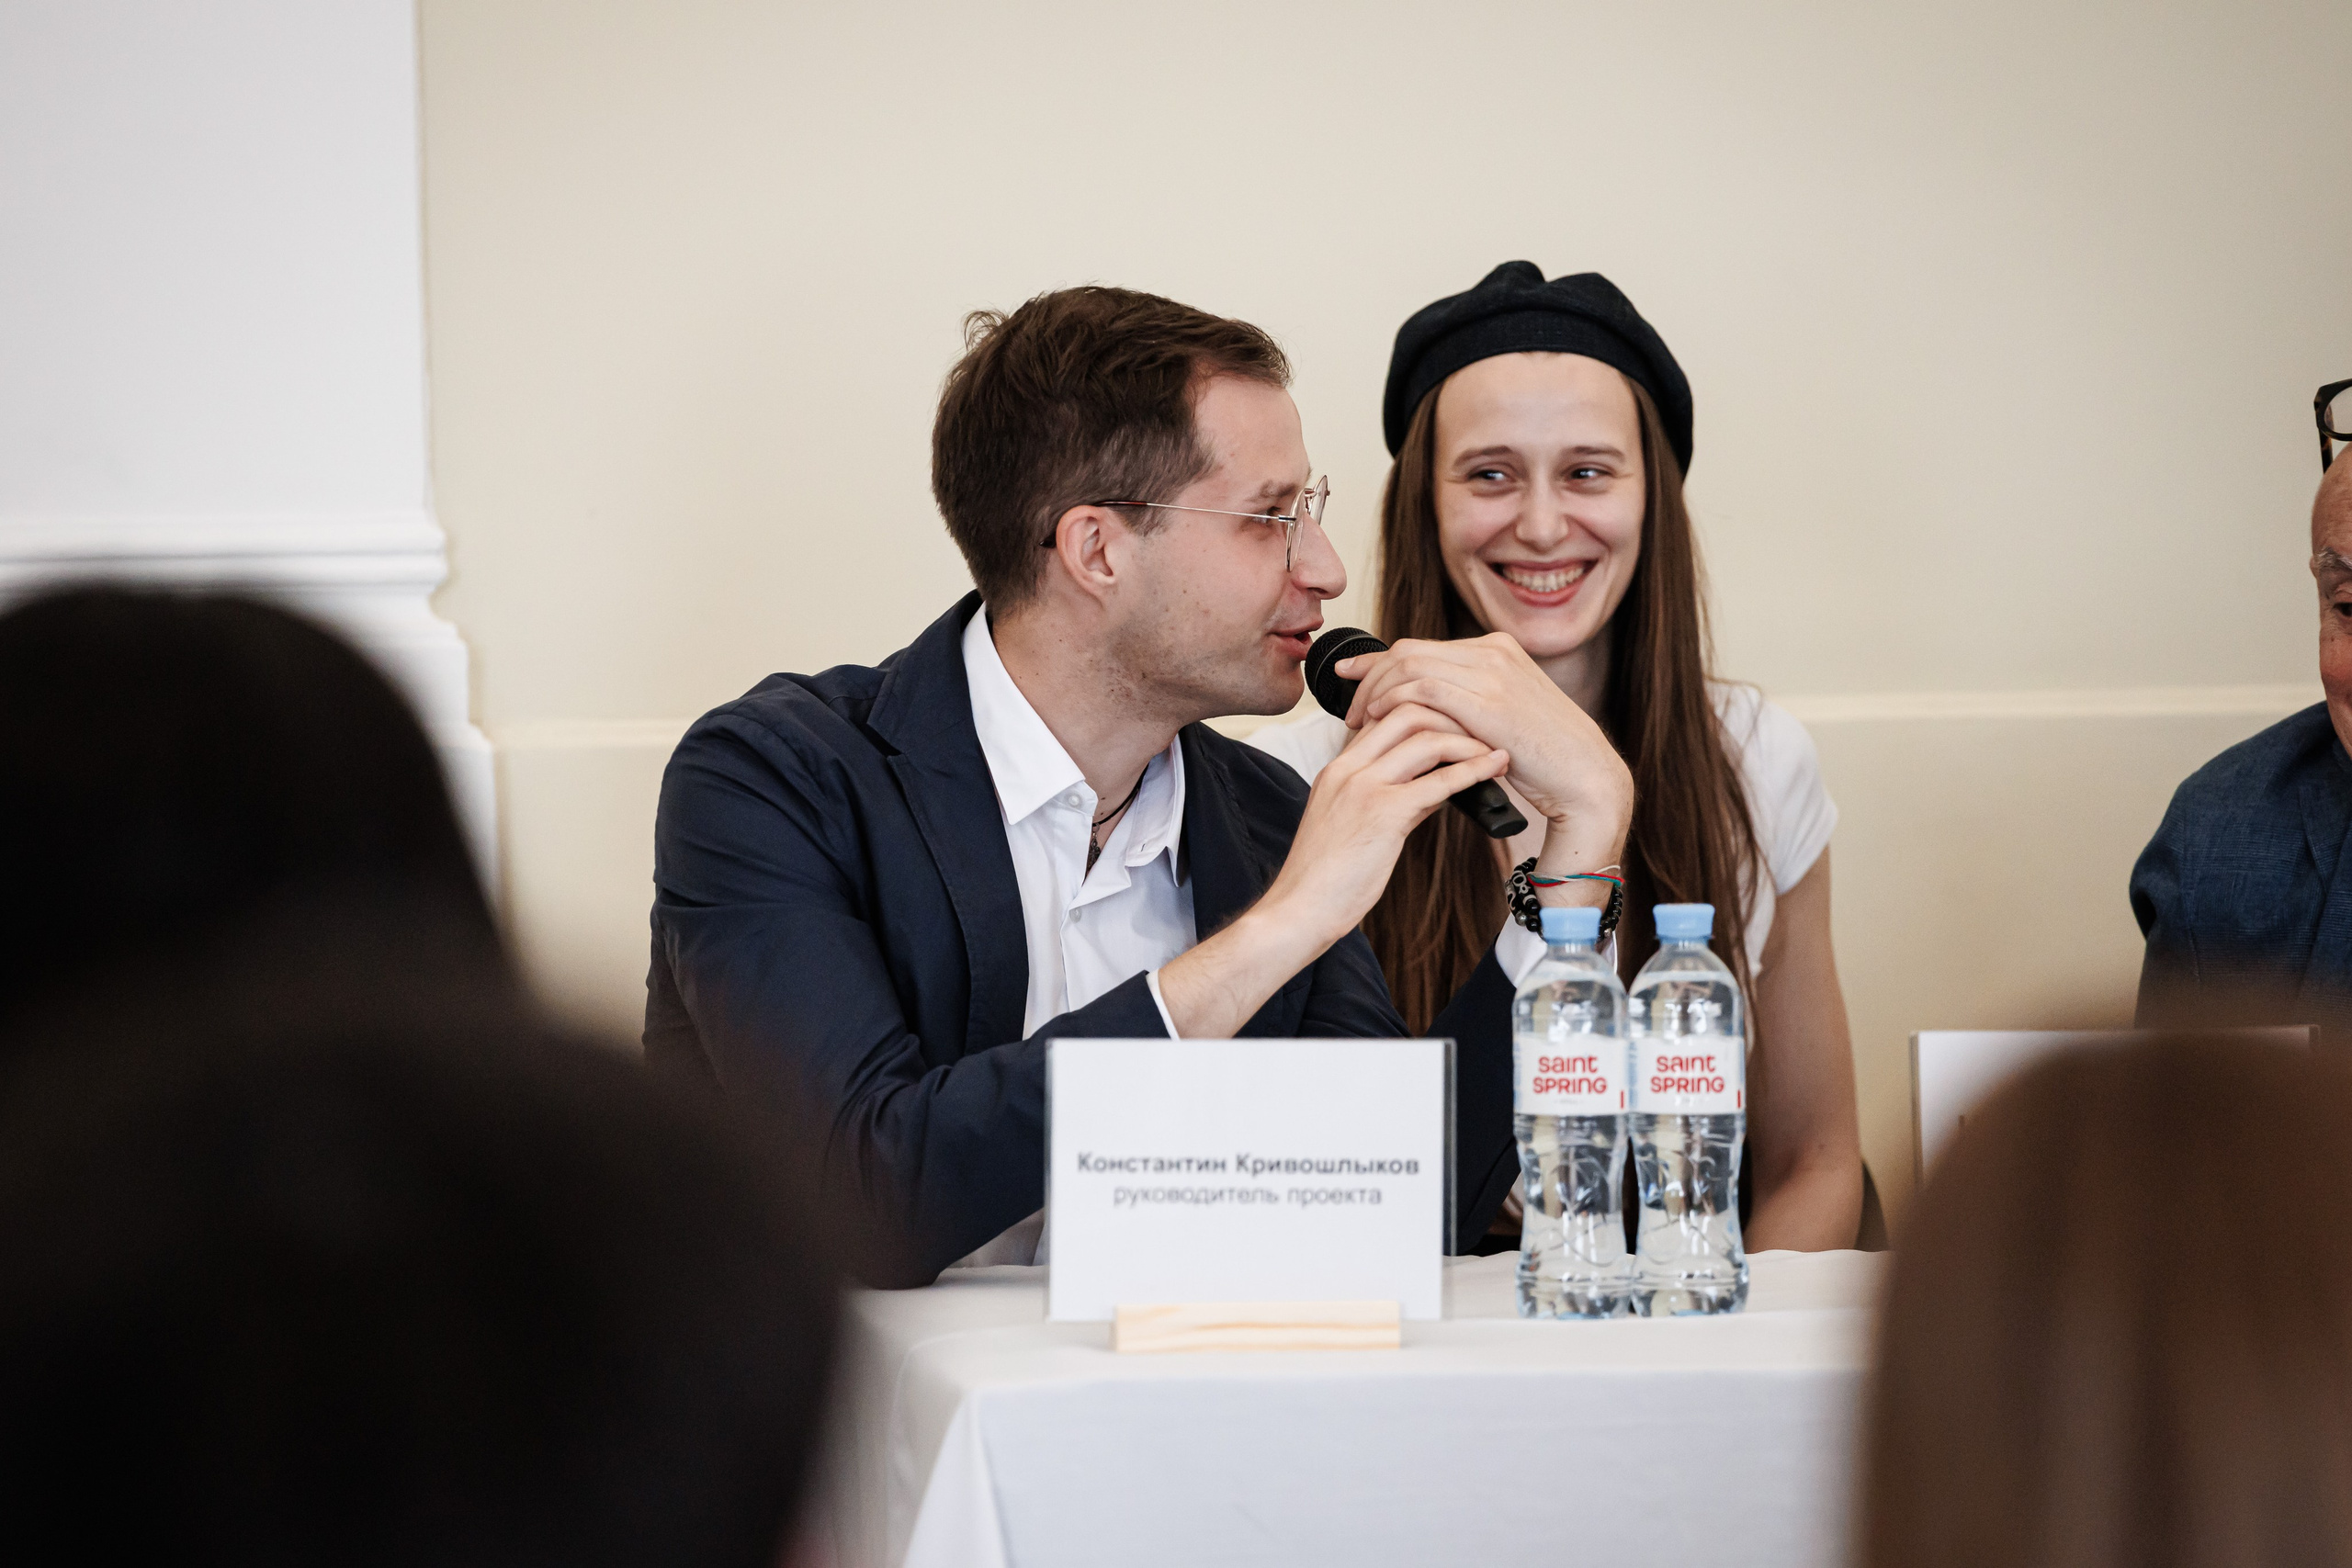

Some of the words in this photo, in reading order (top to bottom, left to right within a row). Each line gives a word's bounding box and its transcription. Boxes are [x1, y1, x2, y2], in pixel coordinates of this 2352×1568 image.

[1532, 1077, 1608, 1095] SPRING
[1650, 1076, 1725, 1094] SPRING
[1078, 1152, 1227, 1173] Константин
[1235, 1153, 1419, 1177] Кривошлыков
[1114, 1185, 1280, 1207] руководитель
[1287, 1186, 1383, 1207] проекта
